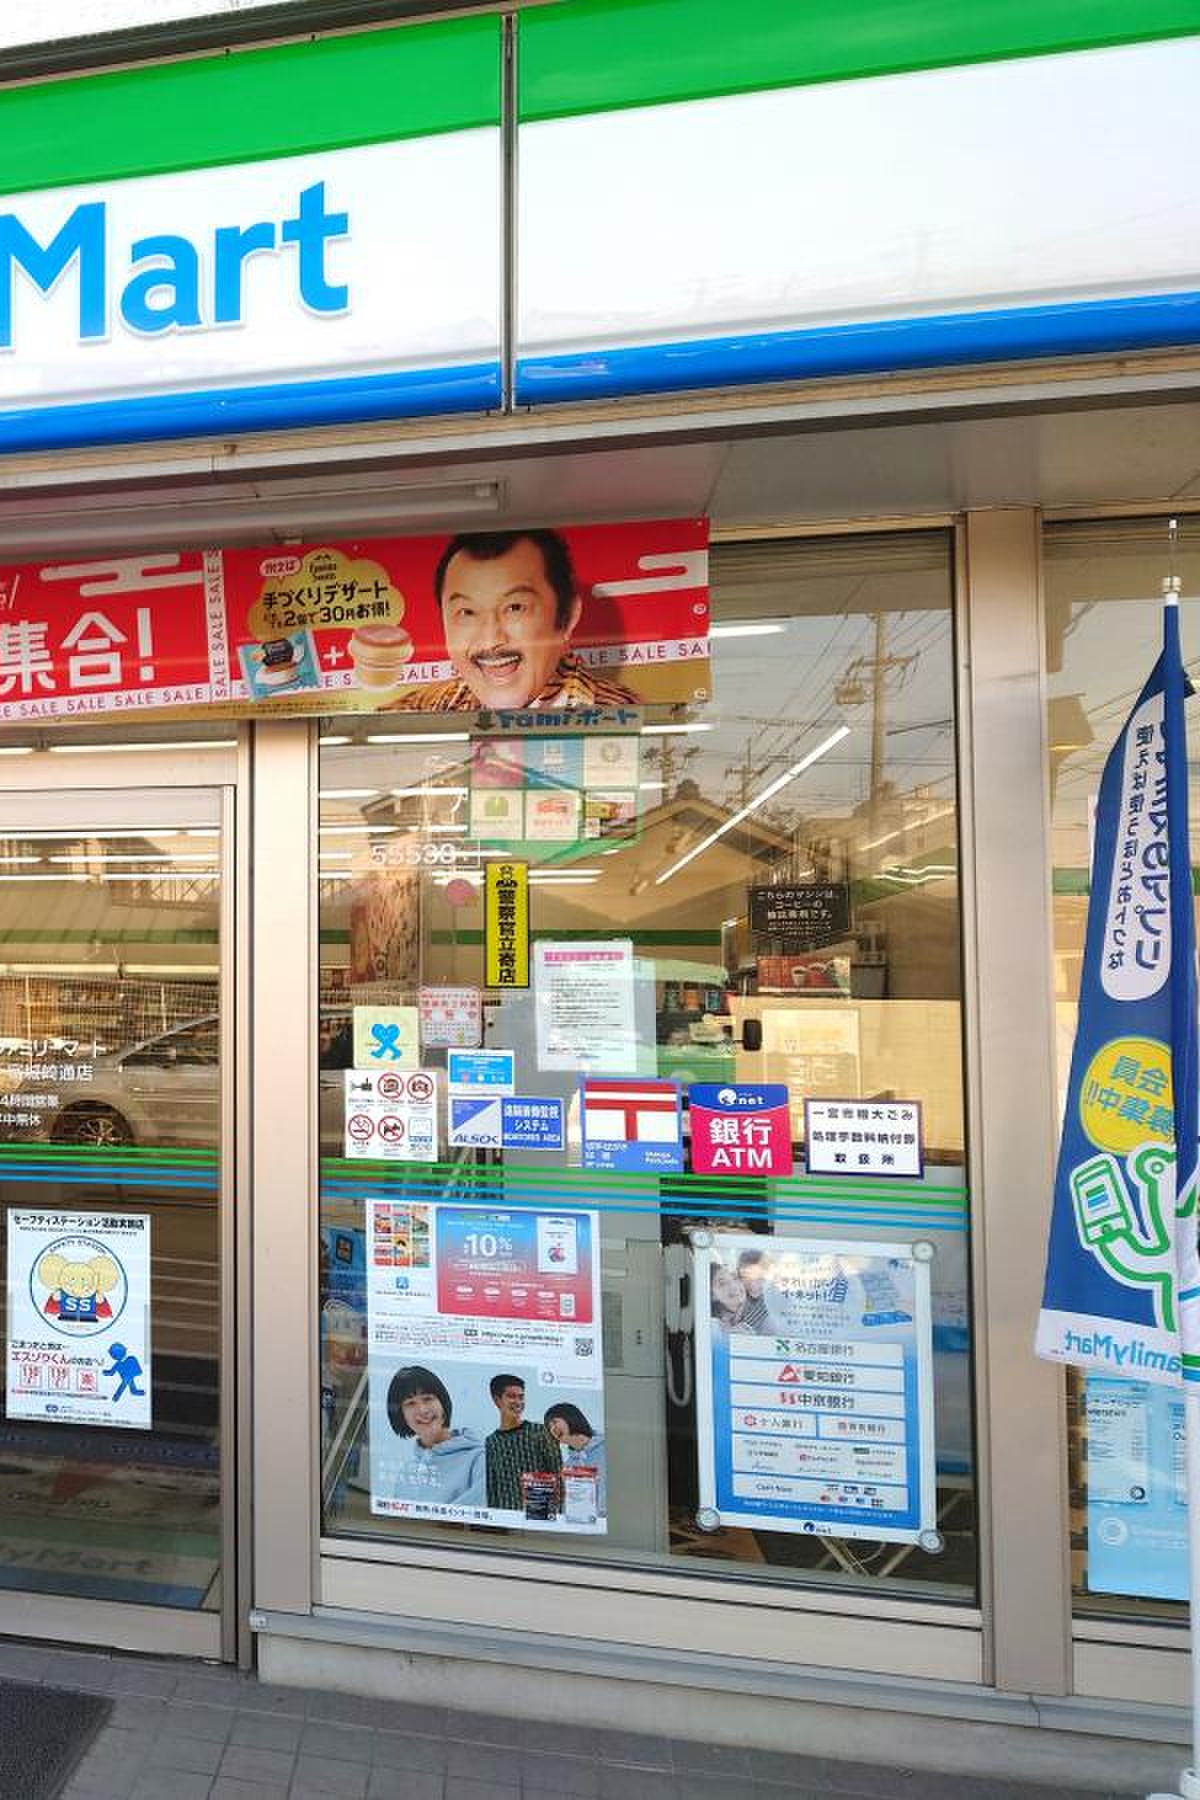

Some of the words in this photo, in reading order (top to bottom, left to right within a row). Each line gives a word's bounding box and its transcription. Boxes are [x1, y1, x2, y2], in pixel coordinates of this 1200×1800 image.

[207, 567, 224, 605] SALE
[262, 580, 389, 609] 手づくりデザート
[209, 611, 227, 650] SALE
[576, 653, 609, 667] ALE
[619, 644, 666, 661] SALE
[20, 701, 59, 717] SALE
[66, 696, 106, 713] SALE
[114, 690, 155, 706] SALE
[162, 686, 204, 702] SALE
[497, 889, 517, 984] 警察官立寄店
[513, 1119, 550, 1132] システム
[811, 1107, 914, 1122] 一宮市粗大ごみ
[452, 1132, 500, 1145] ALSOK
[708, 1117, 773, 1146] 銀行
[710, 1148, 774, 1169] ATM
[833, 1152, 896, 1167] 取扱所
[65, 1297, 92, 1312] SS
[798, 1393, 856, 1410] 中京銀行
